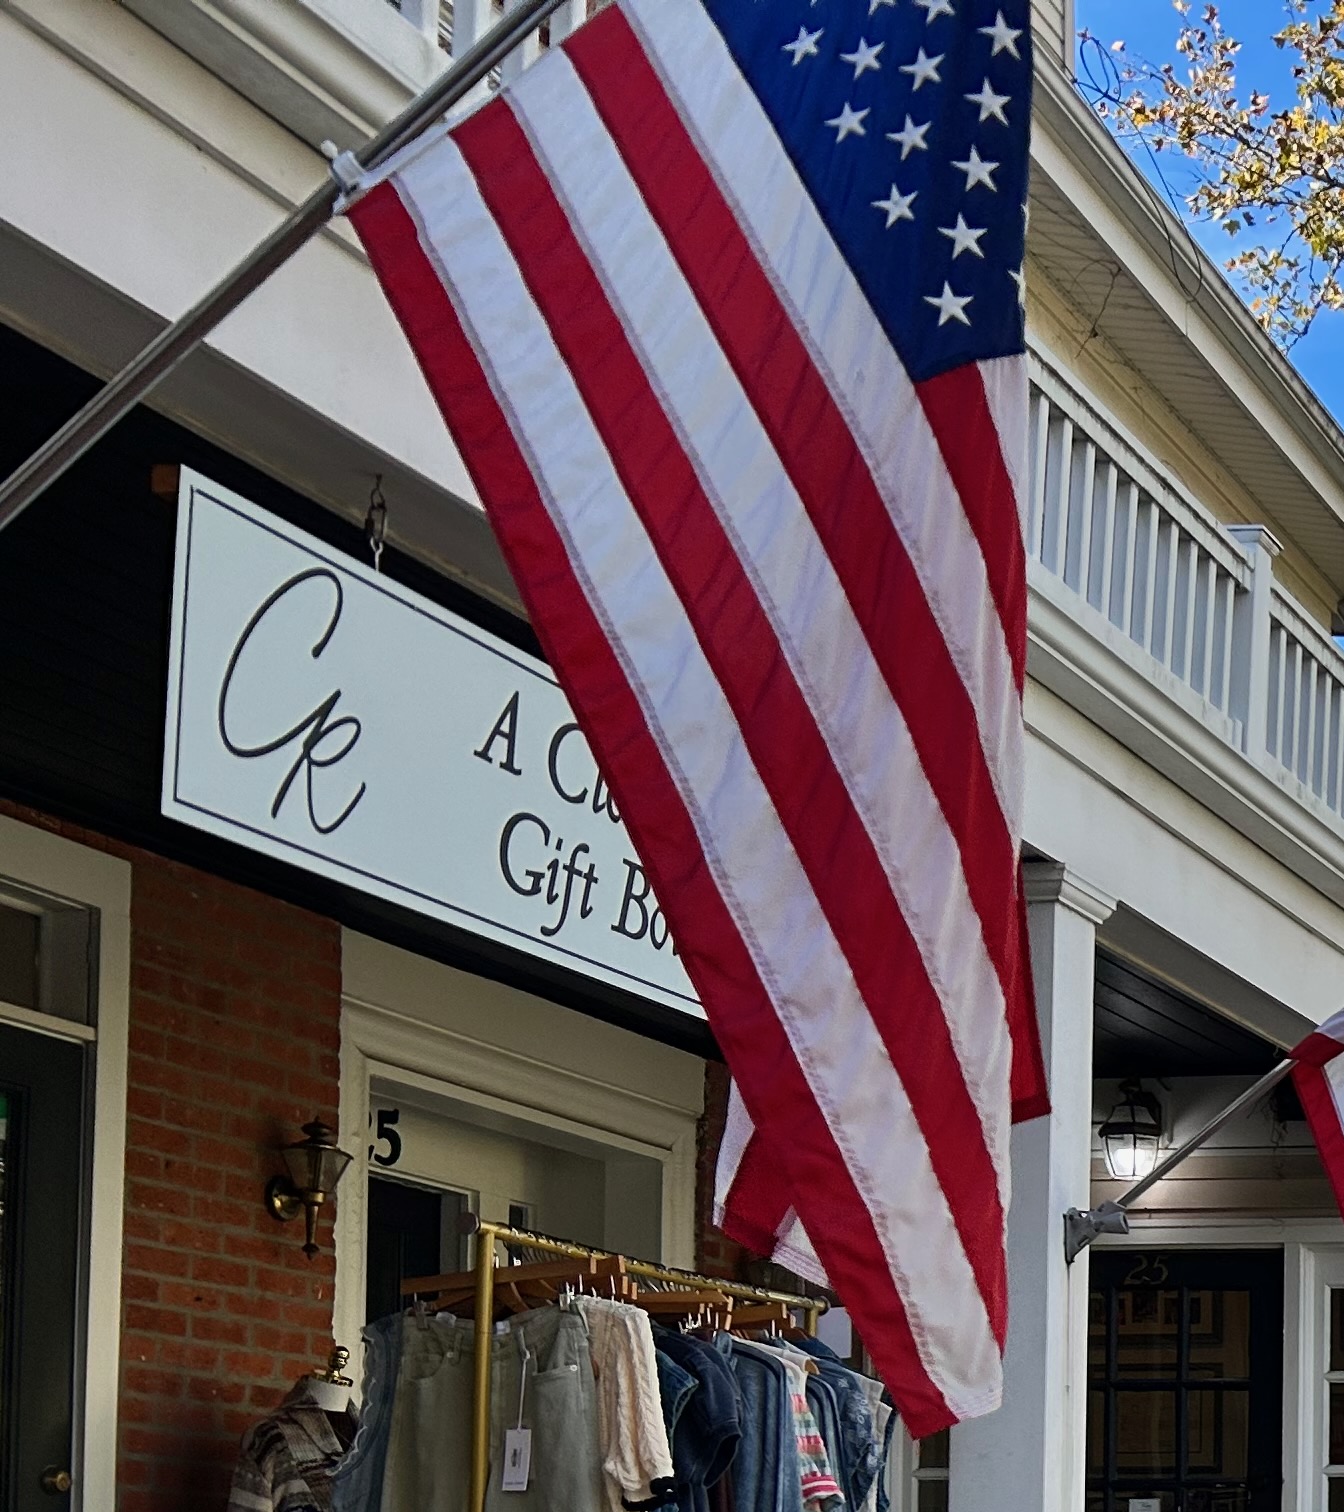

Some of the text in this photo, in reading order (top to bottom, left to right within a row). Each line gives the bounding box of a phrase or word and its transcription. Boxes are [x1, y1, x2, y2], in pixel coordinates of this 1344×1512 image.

[473, 690, 522, 776] A
[499, 812, 681, 956] Gift Bo
[367, 1108, 402, 1167] 5
[1123, 1254, 1169, 1286] 25
